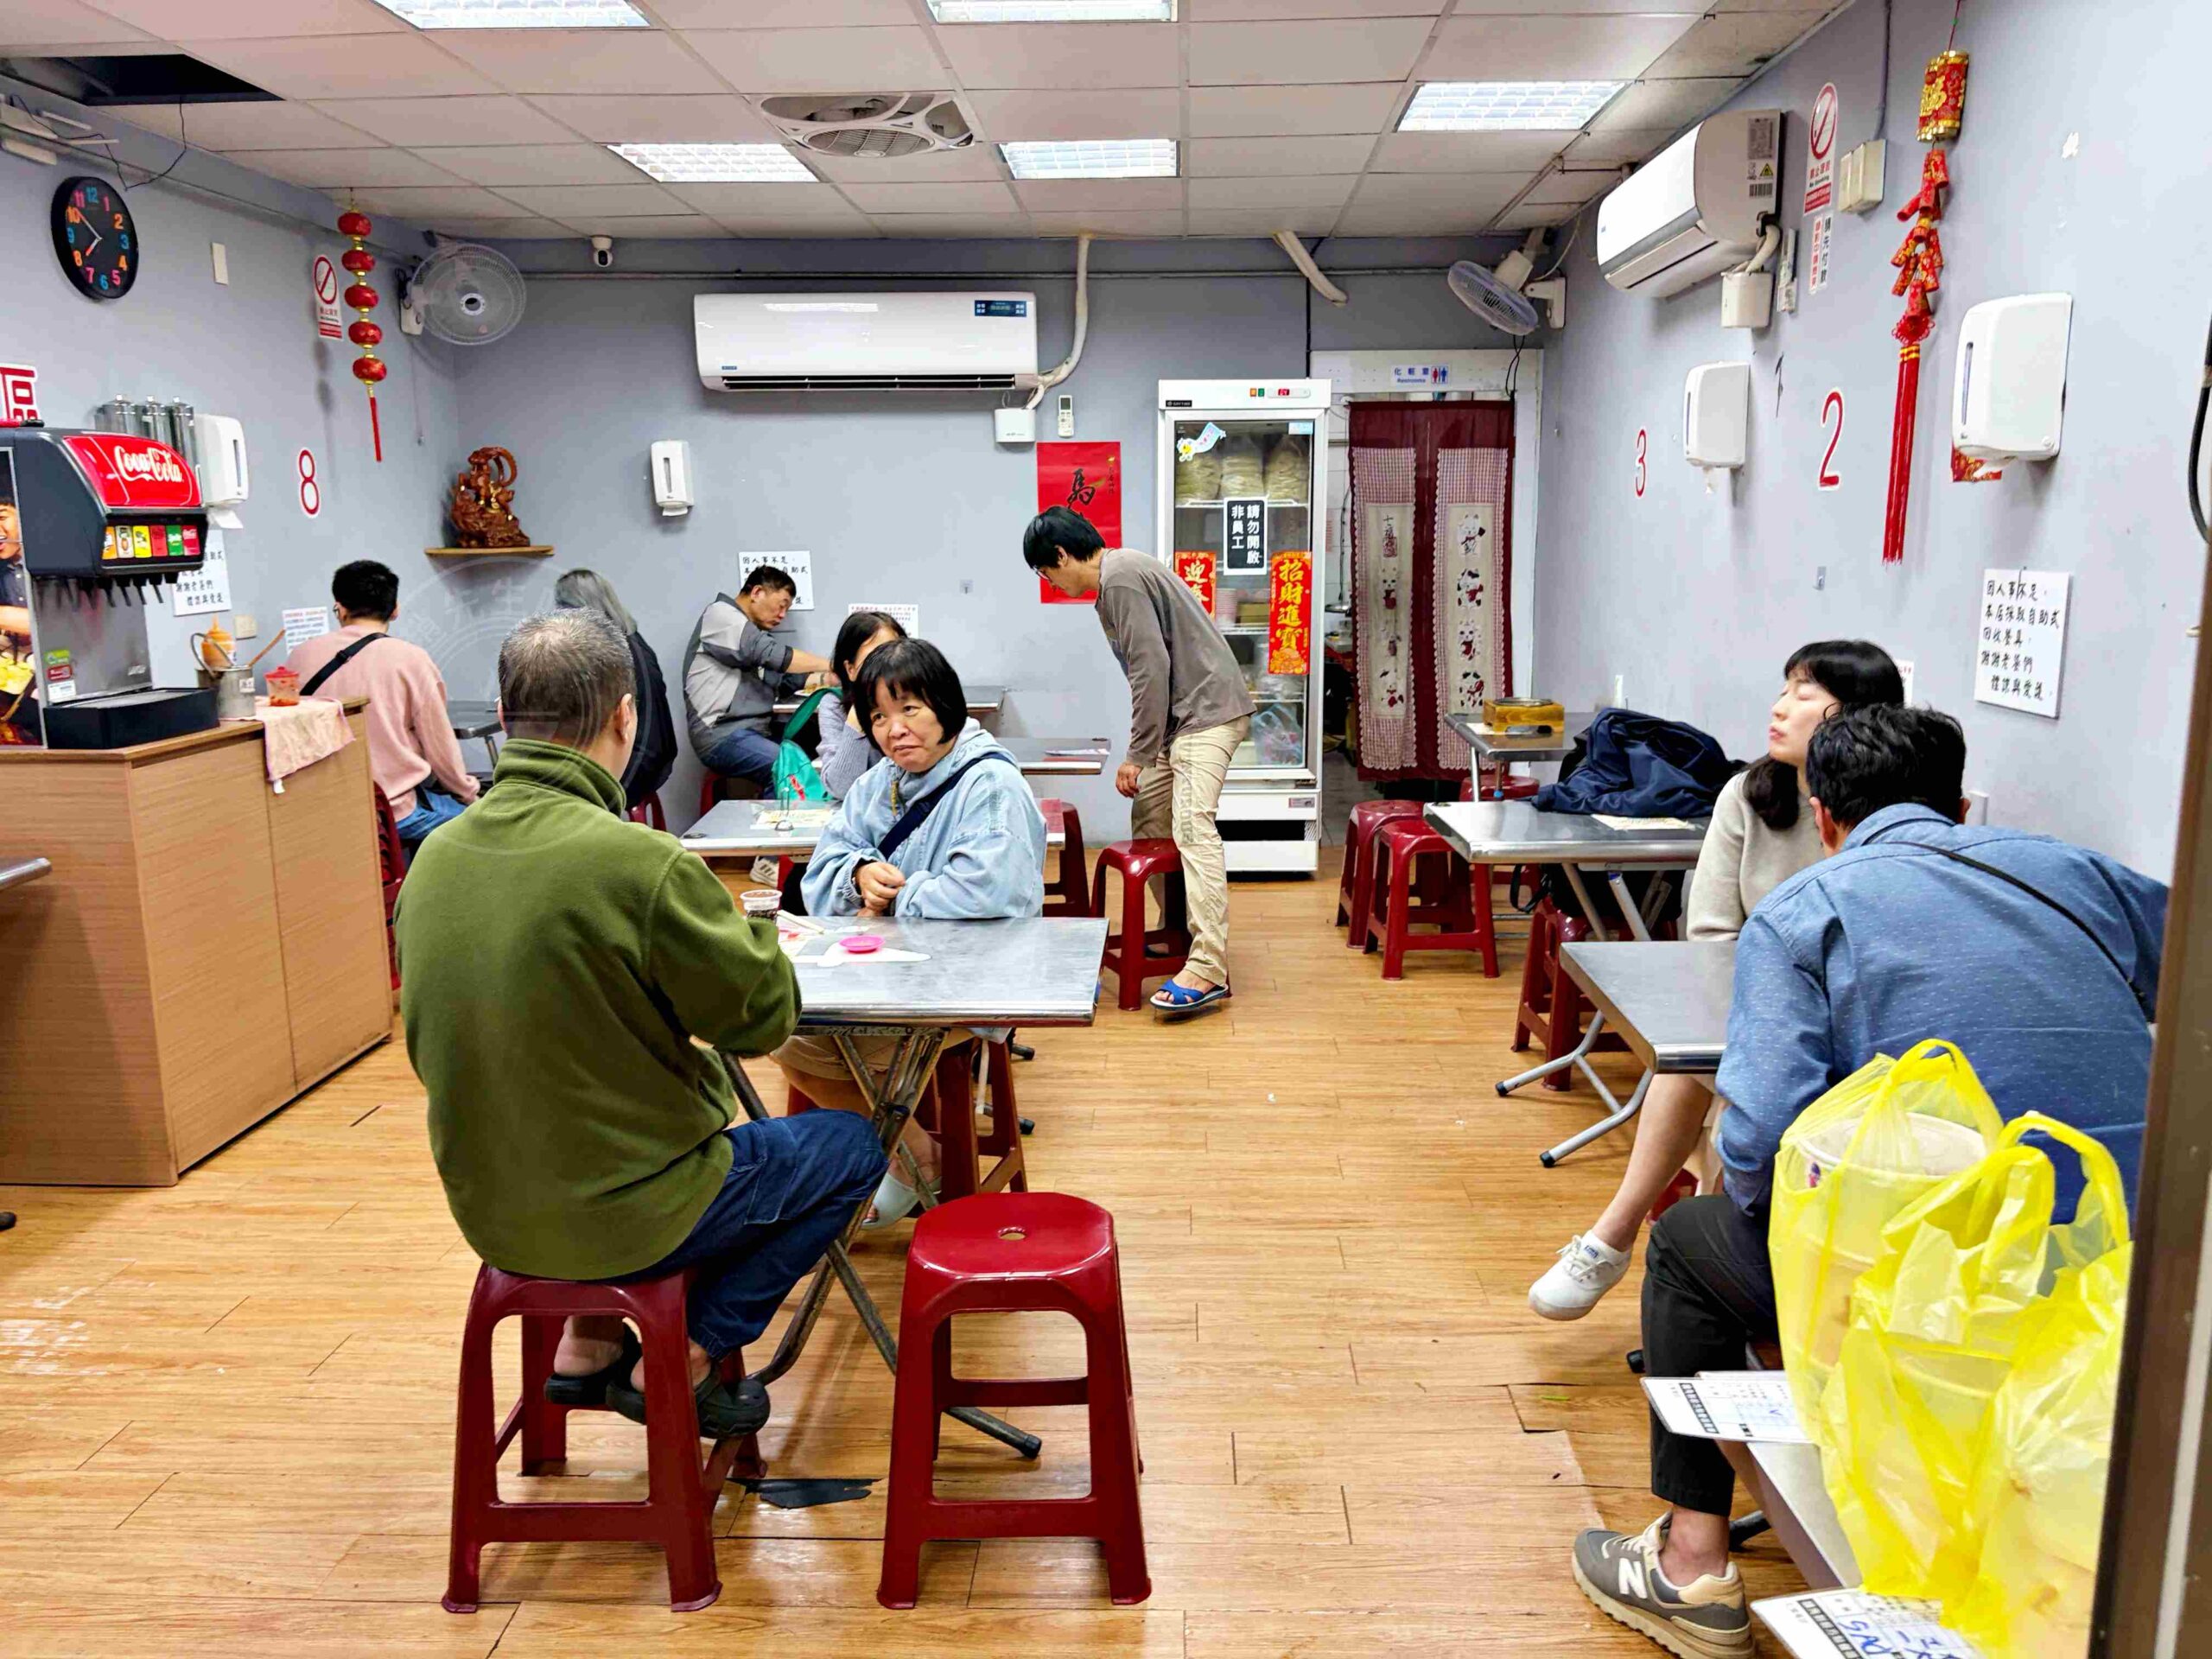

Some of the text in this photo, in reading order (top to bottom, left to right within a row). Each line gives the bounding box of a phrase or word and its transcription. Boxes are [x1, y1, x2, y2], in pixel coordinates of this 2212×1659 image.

[74, 191, 85, 208] 11
[86, 187, 99, 203] 12
[104, 196, 110, 212] 1
[113, 213, 124, 230] 2
[67, 227, 74, 244] 9
[120, 234, 129, 250] 3
[73, 250, 83, 266] 8
[118, 255, 128, 271] 4
[85, 267, 94, 283] 7
[99, 274, 108, 289] 6
[111, 270, 121, 286] 5
[1820, 391, 1844, 486] 2
[1636, 429, 1647, 497] 3
[299, 450, 319, 514] 8
[1231, 505, 1244, 550] 非員工
[1247, 505, 1261, 564] 請勿開啟
[1618, 1558, 1647, 1599] N
